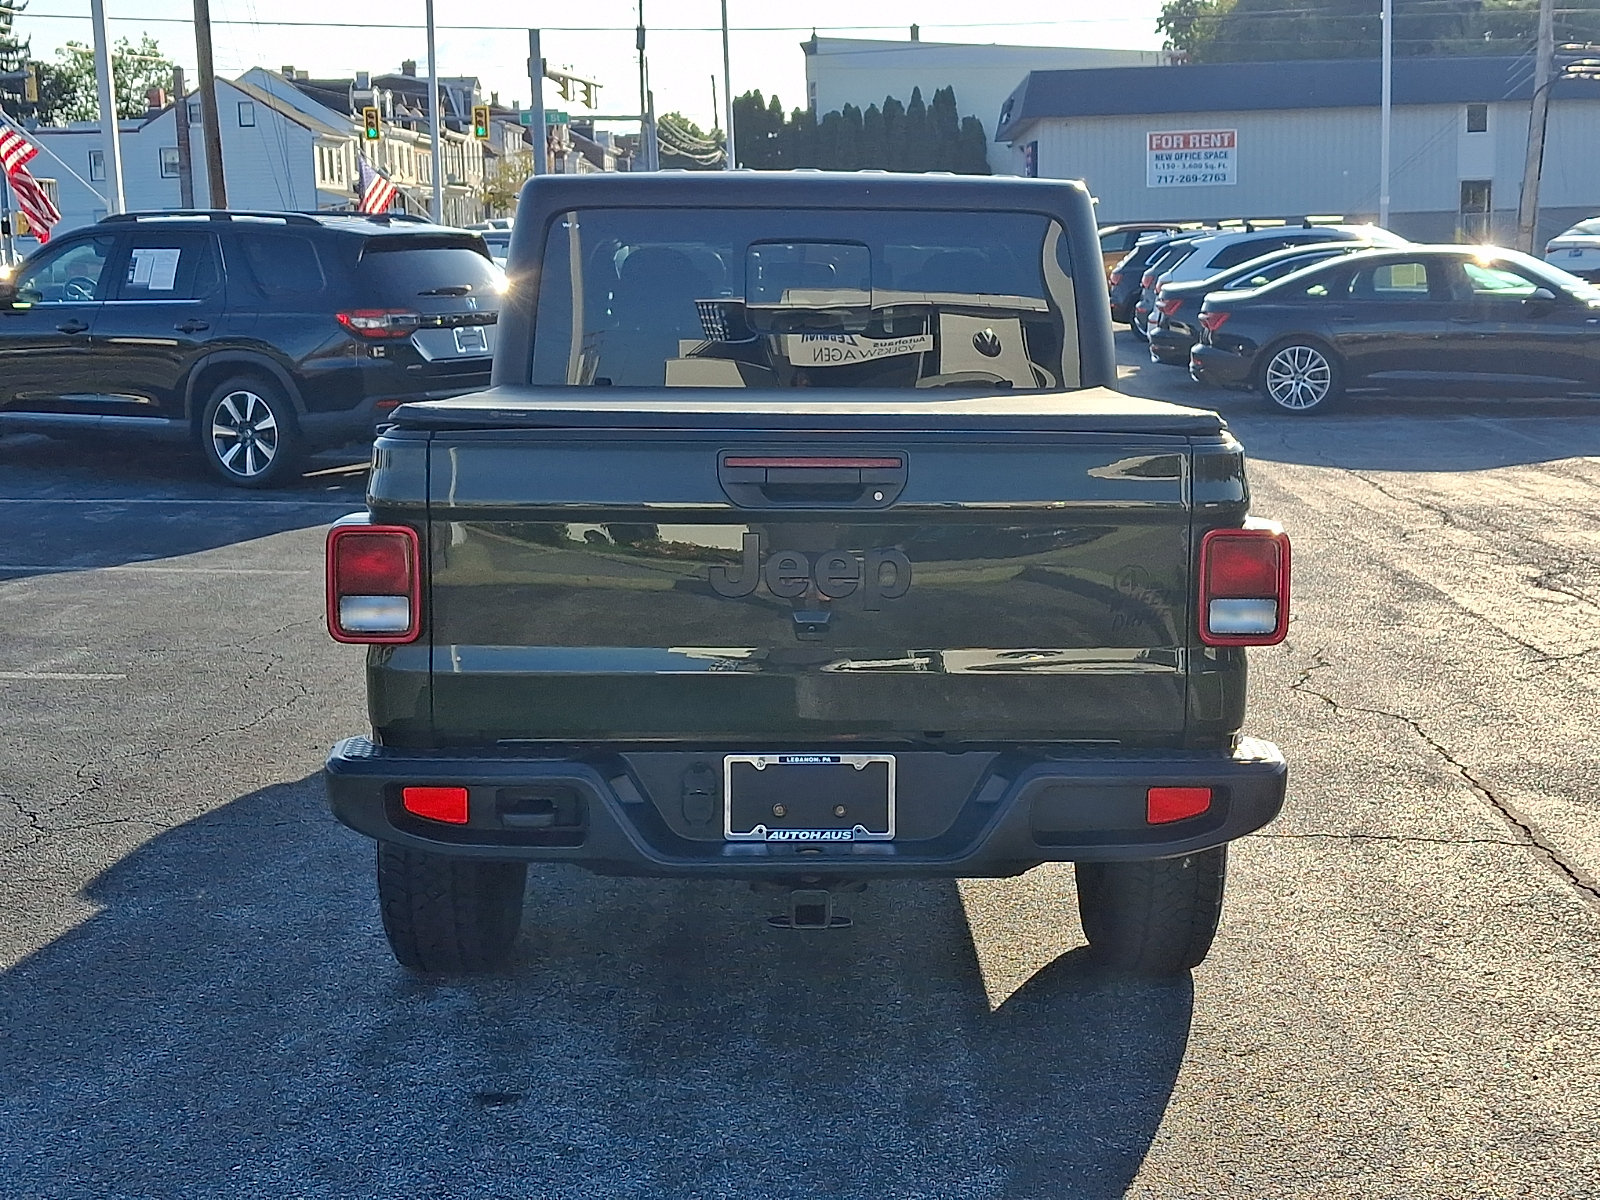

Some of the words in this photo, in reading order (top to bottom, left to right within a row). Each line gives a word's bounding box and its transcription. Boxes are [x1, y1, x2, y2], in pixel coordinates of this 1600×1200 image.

[1152, 135, 1184, 149] FOR
[1189, 133, 1231, 148] RENT
[1155, 153, 1173, 161] NEW
[1174, 152, 1201, 161] OFFICE
[1204, 151, 1228, 160] SPACE
[1157, 173, 1227, 184] 717-269-2763
[708, 532, 912, 611] Jeep
[767, 830, 852, 840] AUTOHAUS
